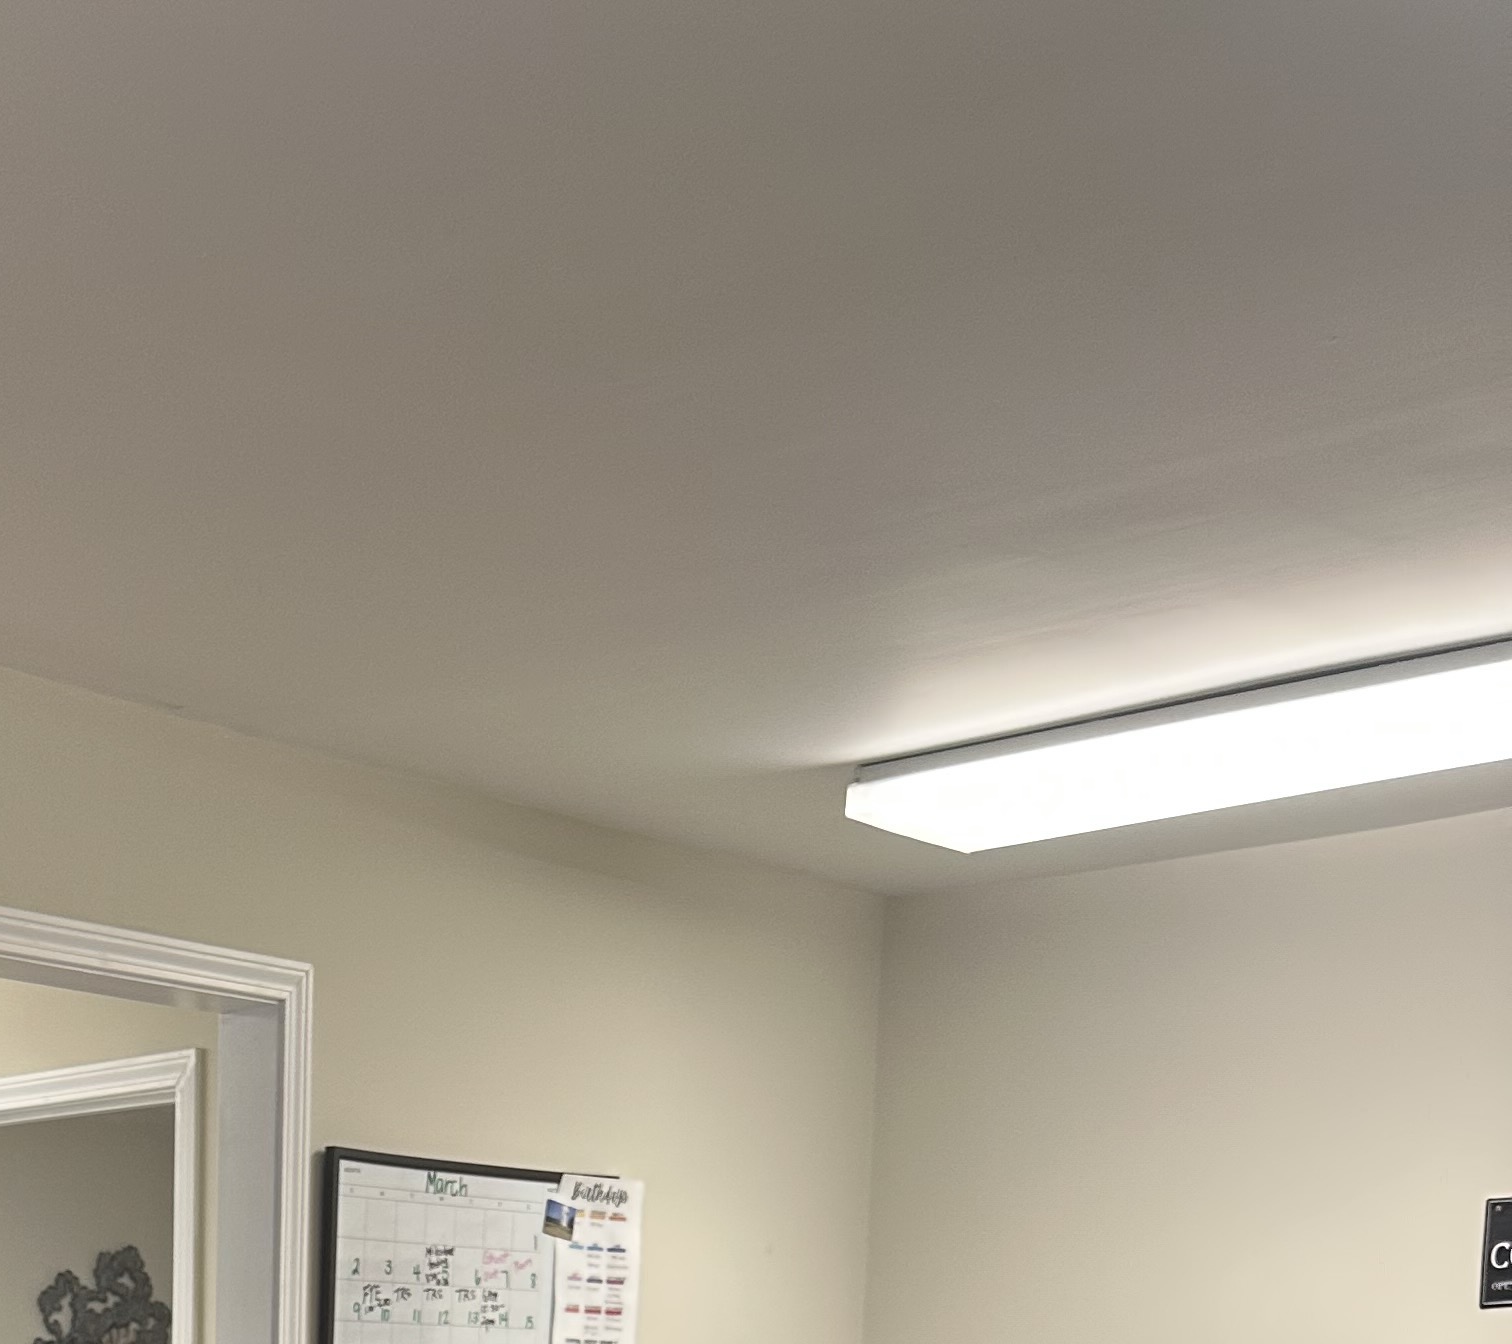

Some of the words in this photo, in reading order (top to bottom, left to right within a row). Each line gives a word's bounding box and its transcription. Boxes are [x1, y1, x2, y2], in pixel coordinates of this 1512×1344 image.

[425, 1171, 468, 1197] March
[1490, 1241, 1512, 1269] C
[351, 1258, 360, 1275] 2
[385, 1260, 393, 1275] 3
[413, 1265, 421, 1283] 4
[455, 1289, 477, 1303] TRS
[353, 1302, 361, 1320] 9
[439, 1310, 449, 1325] 12
[468, 1311, 480, 1324] 13
